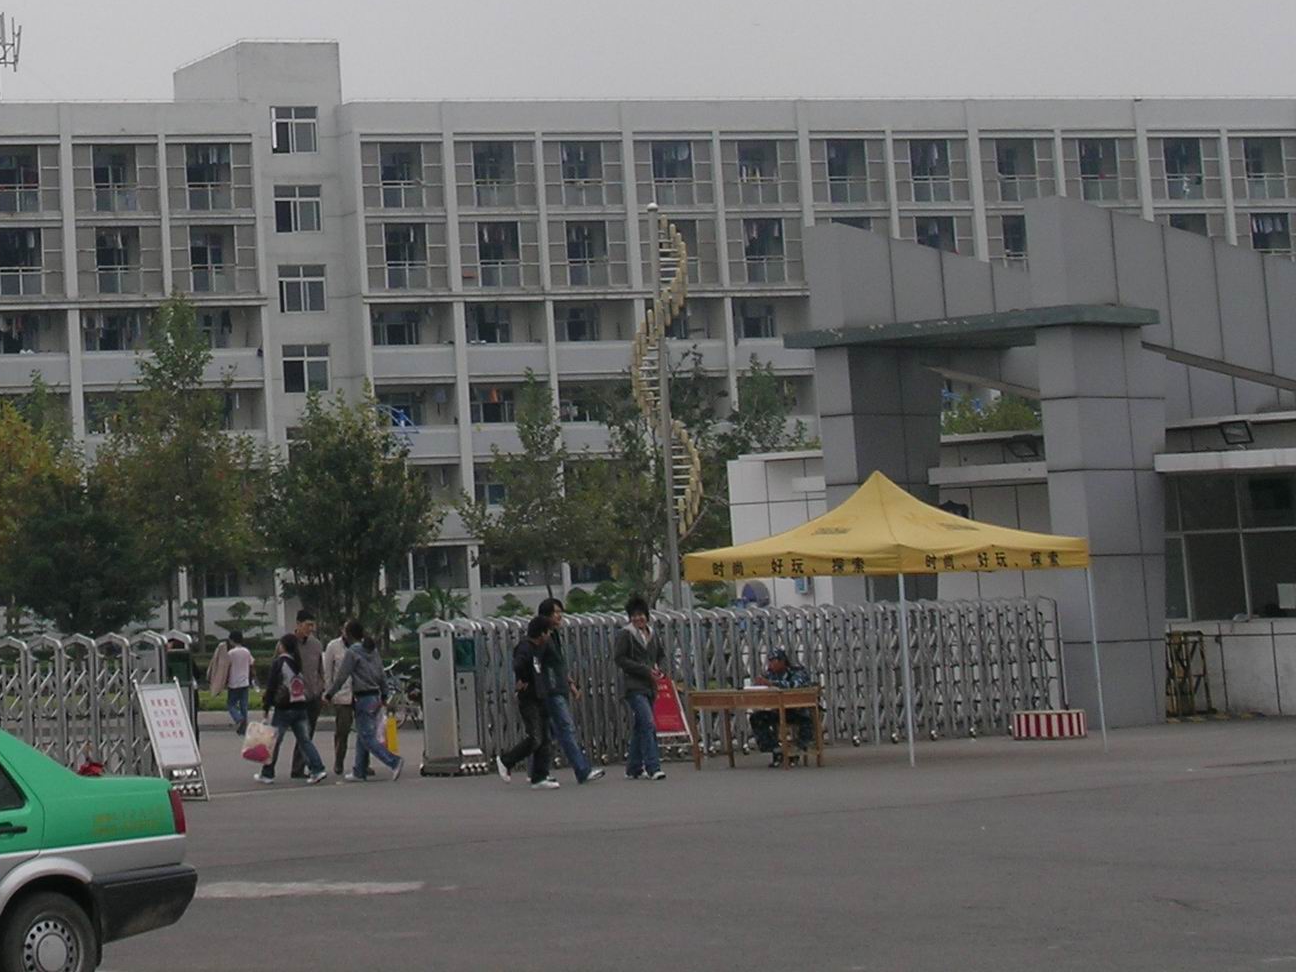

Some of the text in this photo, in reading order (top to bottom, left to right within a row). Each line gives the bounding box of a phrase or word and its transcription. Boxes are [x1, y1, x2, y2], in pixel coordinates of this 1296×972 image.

[713, 557, 865, 577] 时尚、好玩、探索
